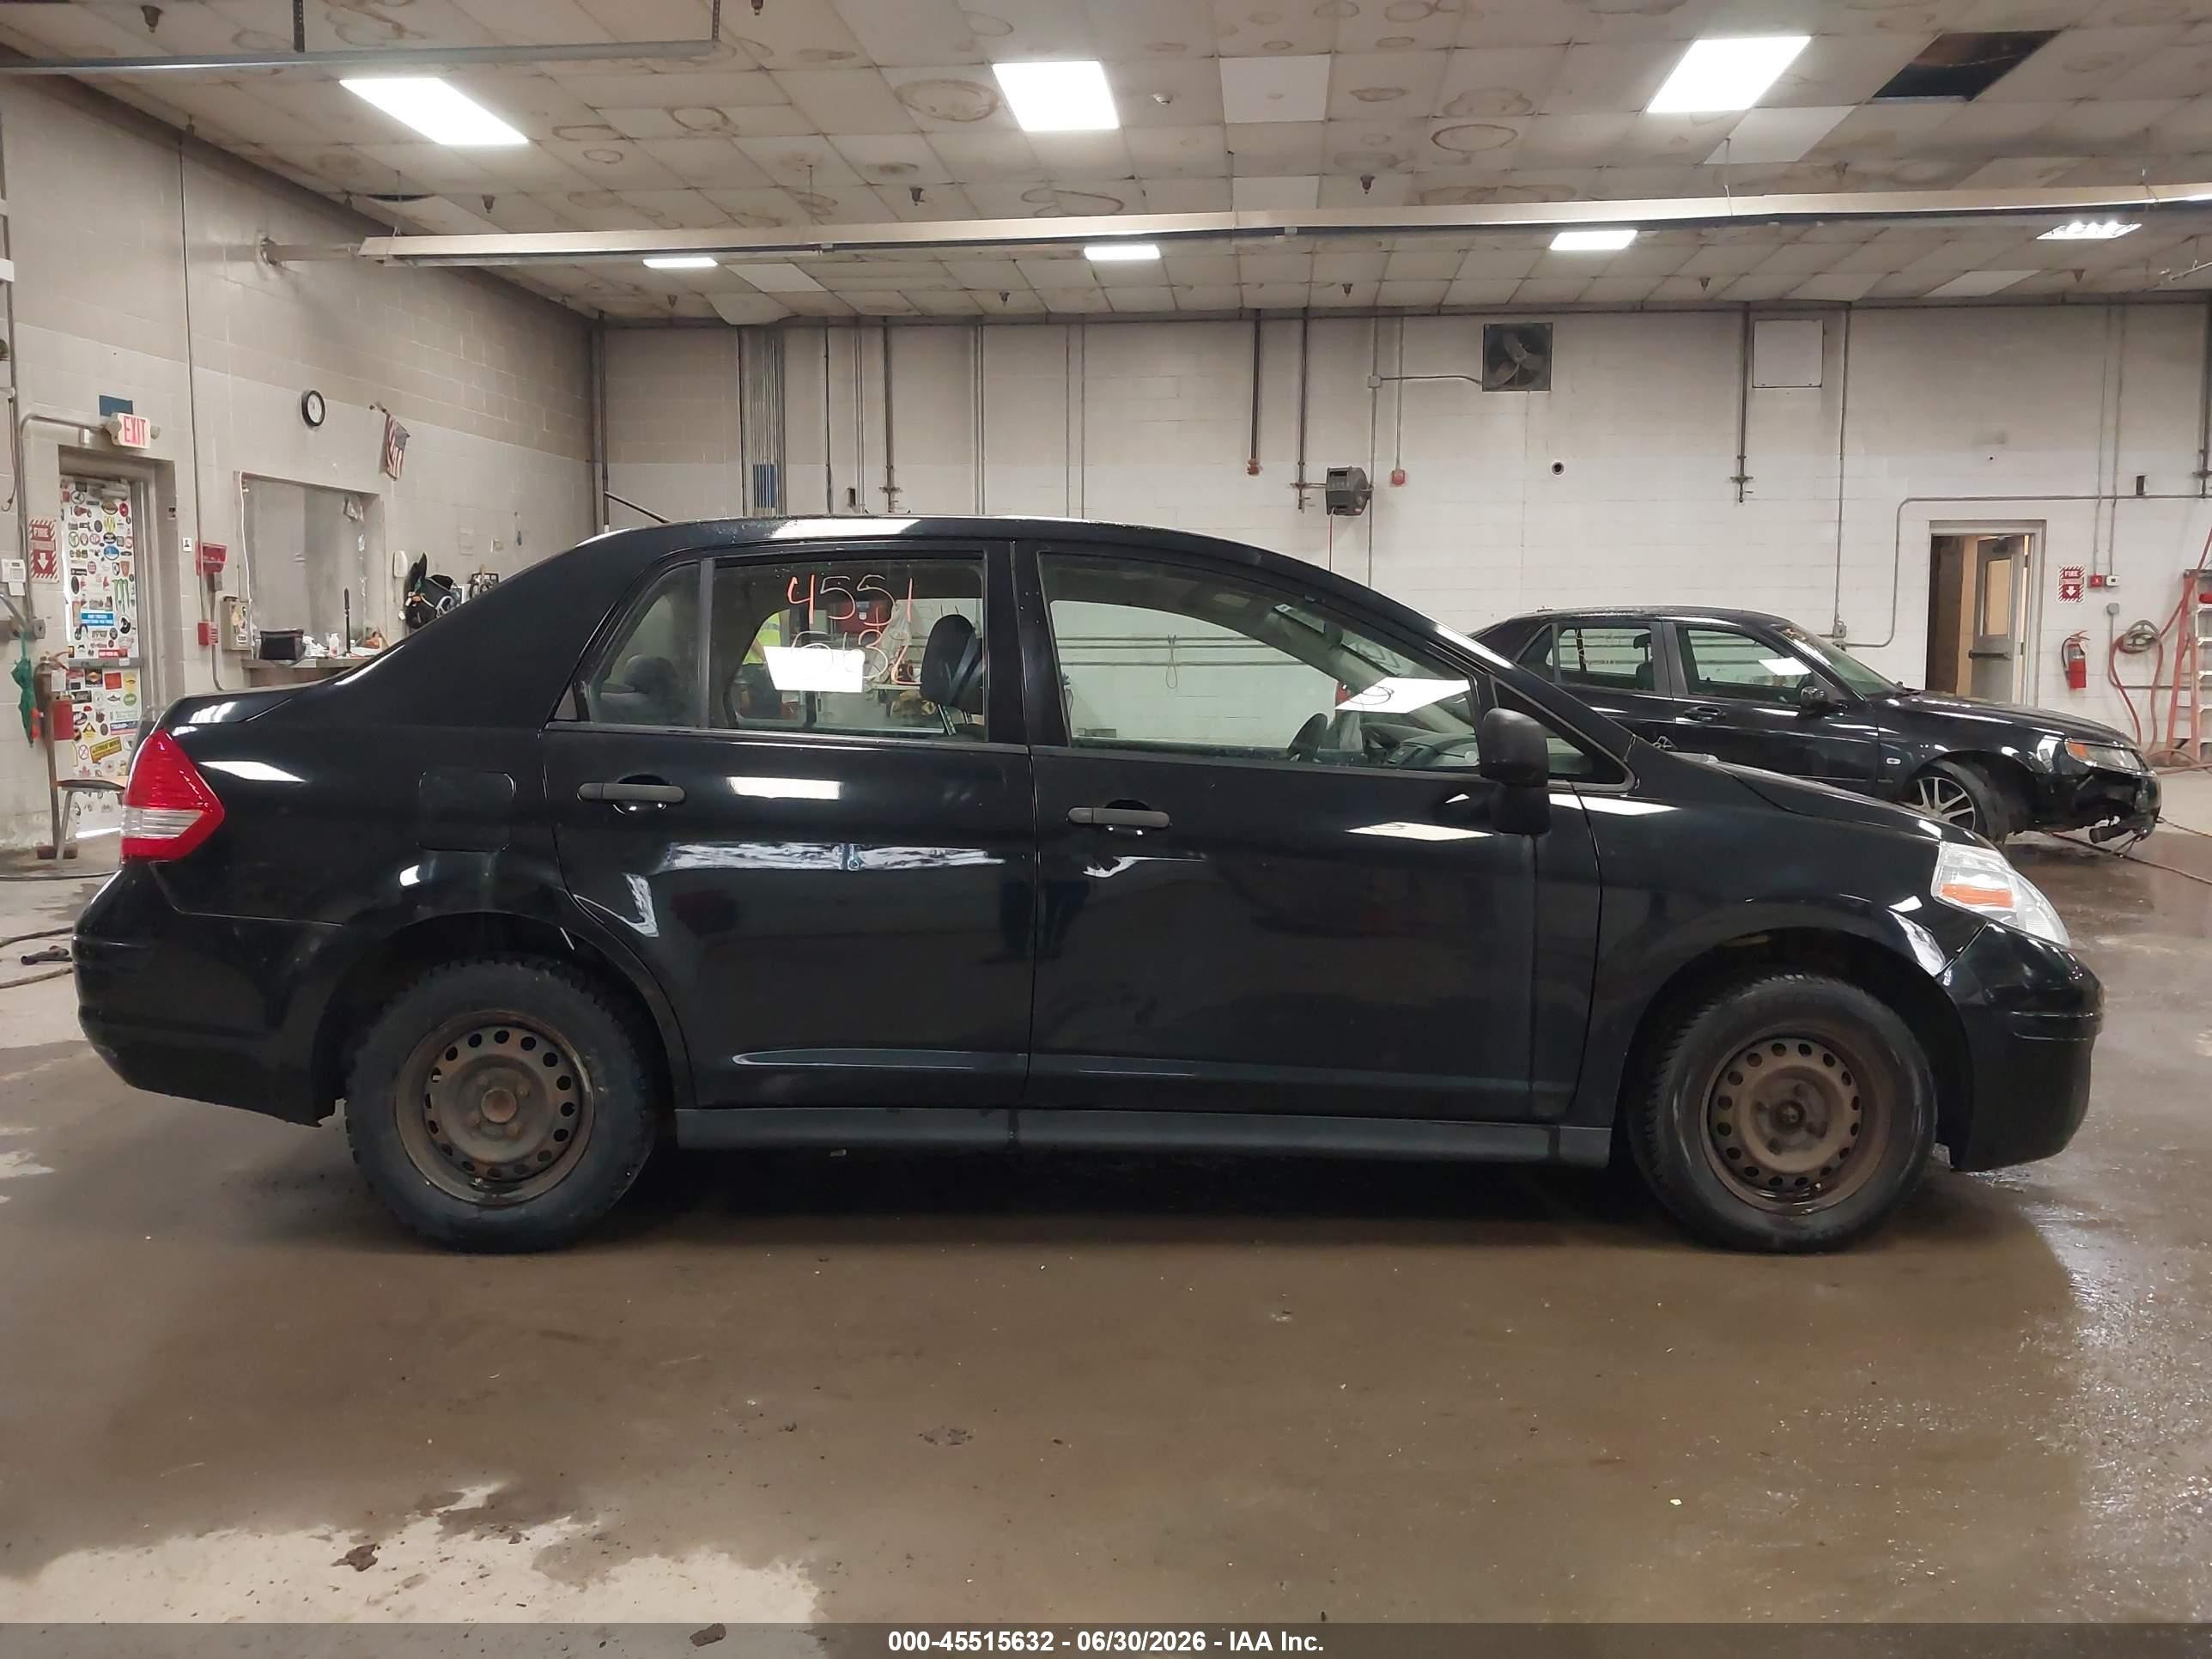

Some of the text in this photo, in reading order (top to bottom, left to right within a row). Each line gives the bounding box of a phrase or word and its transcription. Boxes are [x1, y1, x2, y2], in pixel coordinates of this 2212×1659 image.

[123, 416, 146, 446] EXIT
[33, 527, 49, 538] FIRE
[787, 574, 913, 626] 4551
